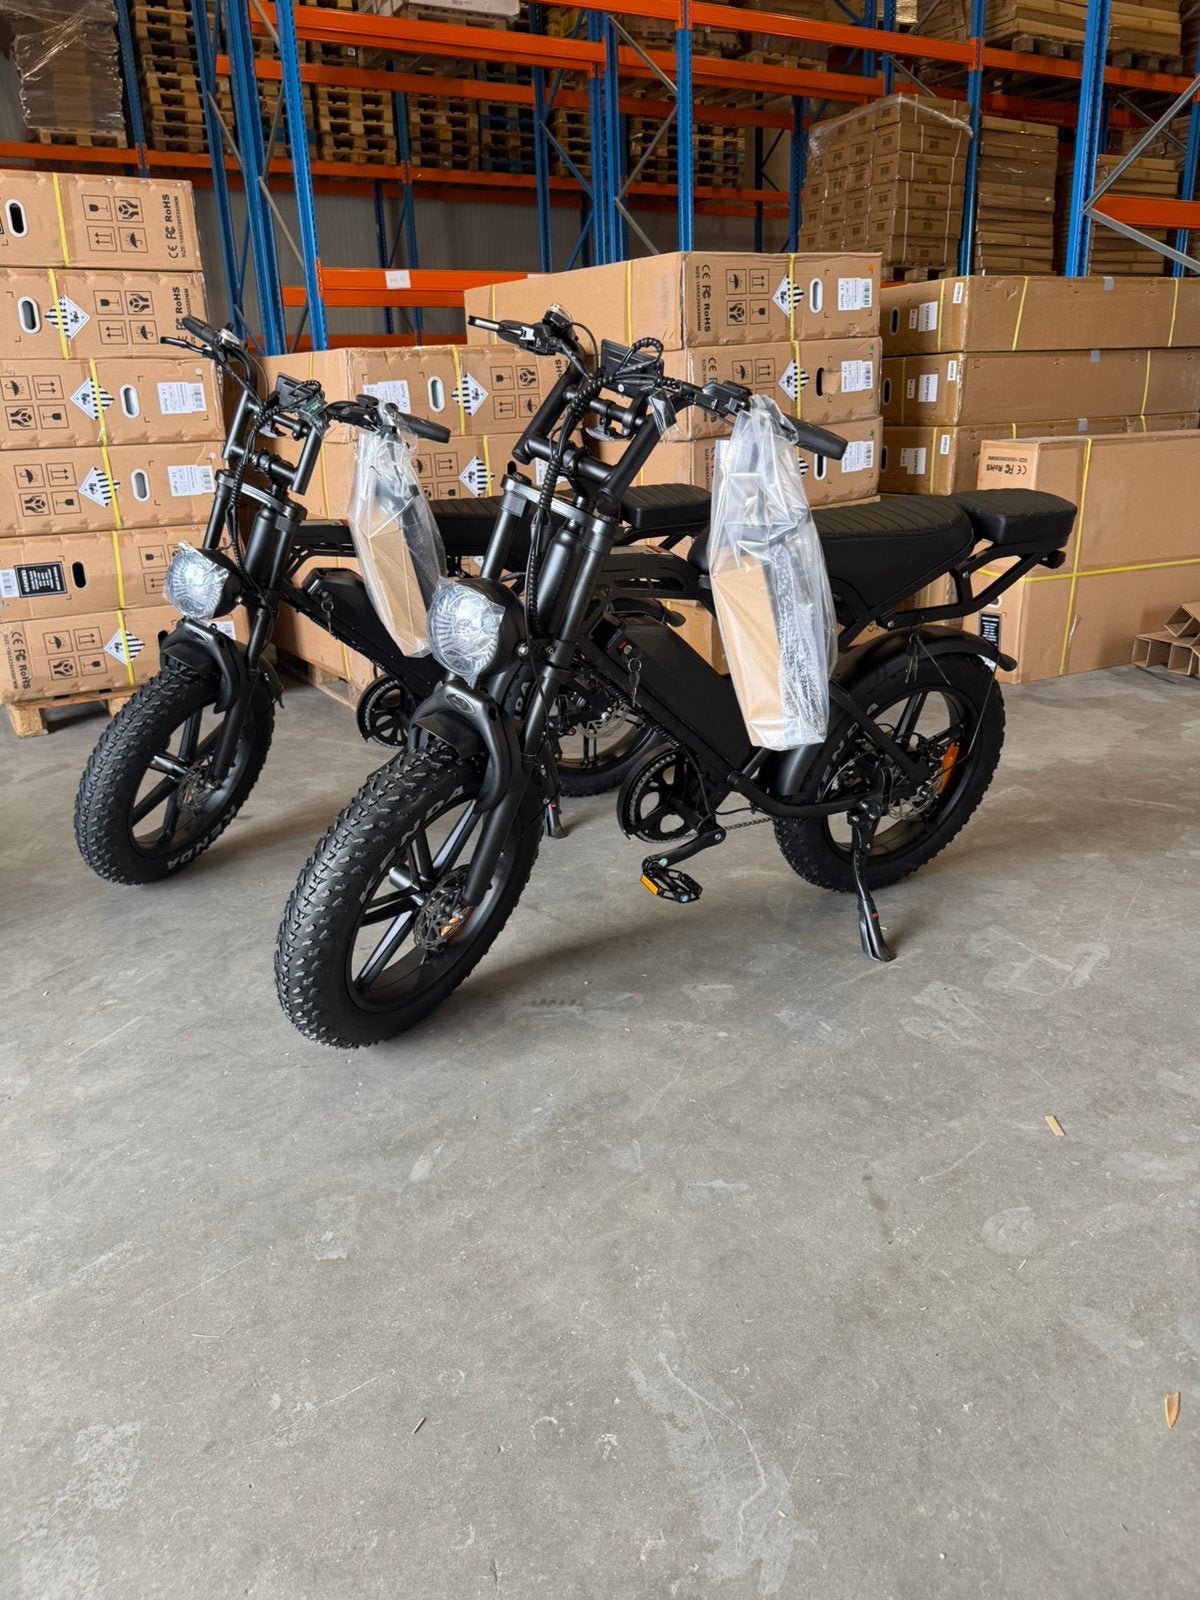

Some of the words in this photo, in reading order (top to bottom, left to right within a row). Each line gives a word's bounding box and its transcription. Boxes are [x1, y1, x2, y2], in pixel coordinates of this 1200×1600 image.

[162, 193, 173, 222] RoHS
[167, 245, 179, 259] CE
[702, 264, 711, 280] CE
[172, 286, 183, 314] RoHS
[708, 357, 717, 372] CE
[11, 631, 24, 645] CE
[19, 664, 31, 690] RoHS
[167, 804, 236, 870] KENDA
